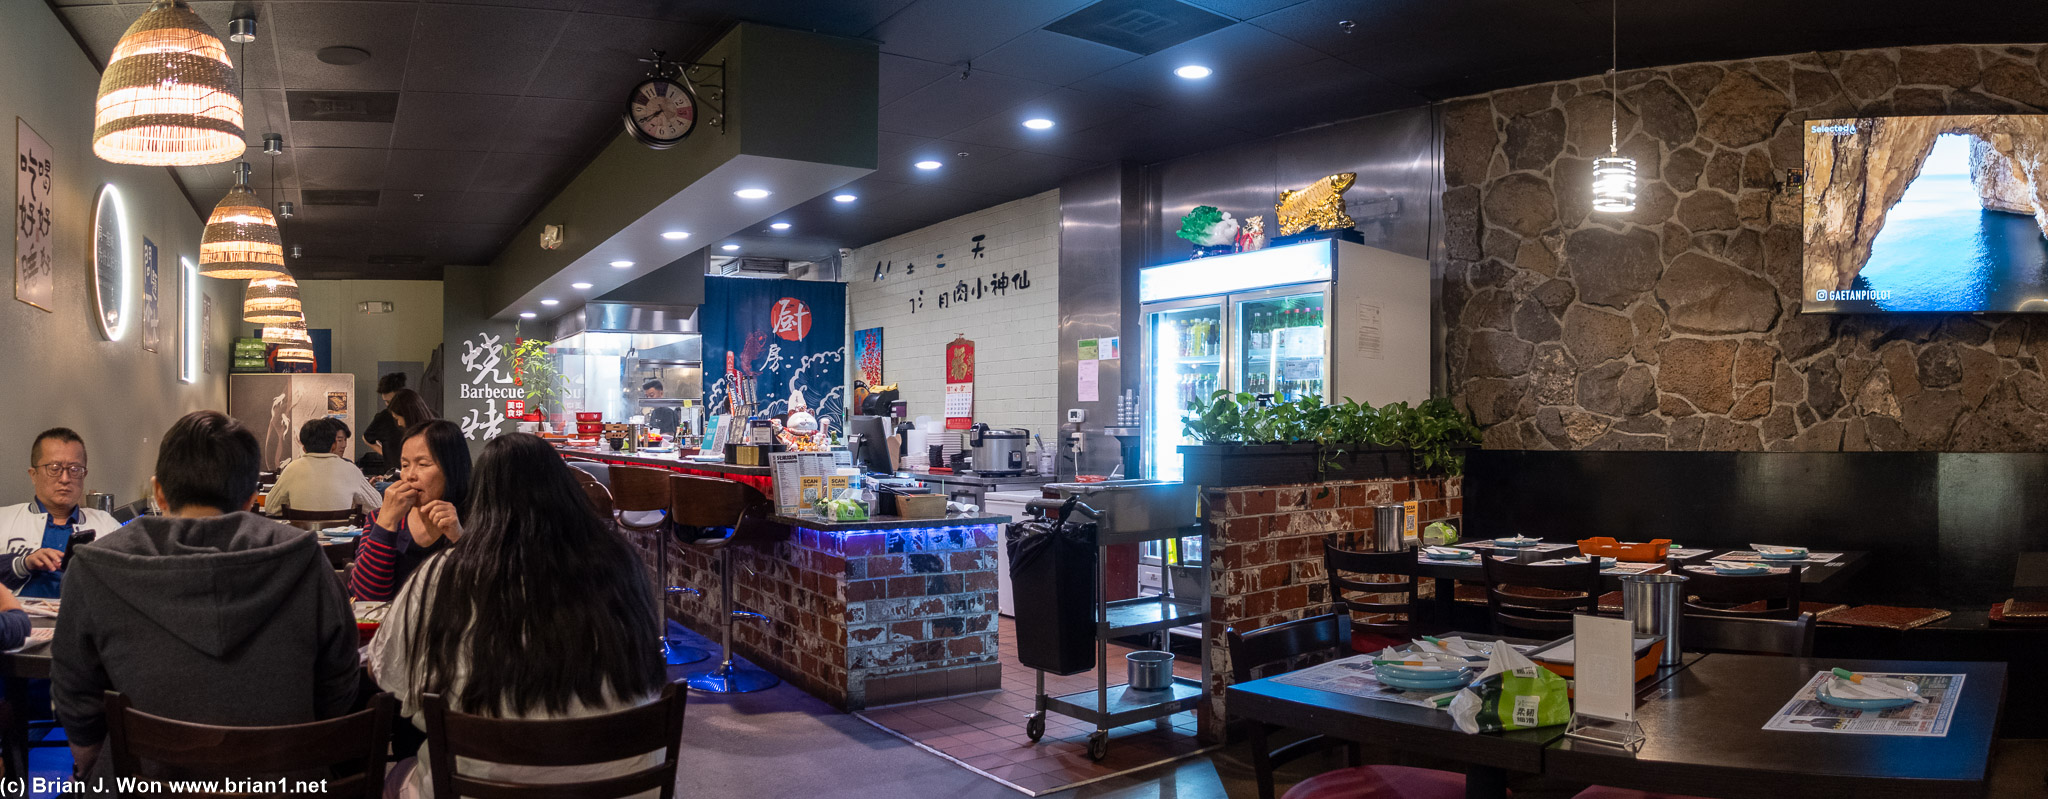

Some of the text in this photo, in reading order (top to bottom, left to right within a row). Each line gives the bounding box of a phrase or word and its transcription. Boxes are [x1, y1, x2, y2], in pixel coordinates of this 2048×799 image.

[1811, 124, 1849, 133] Selected
[1829, 289, 1891, 301] GAETANPIOLOT
[460, 383, 525, 399] Barbecue
